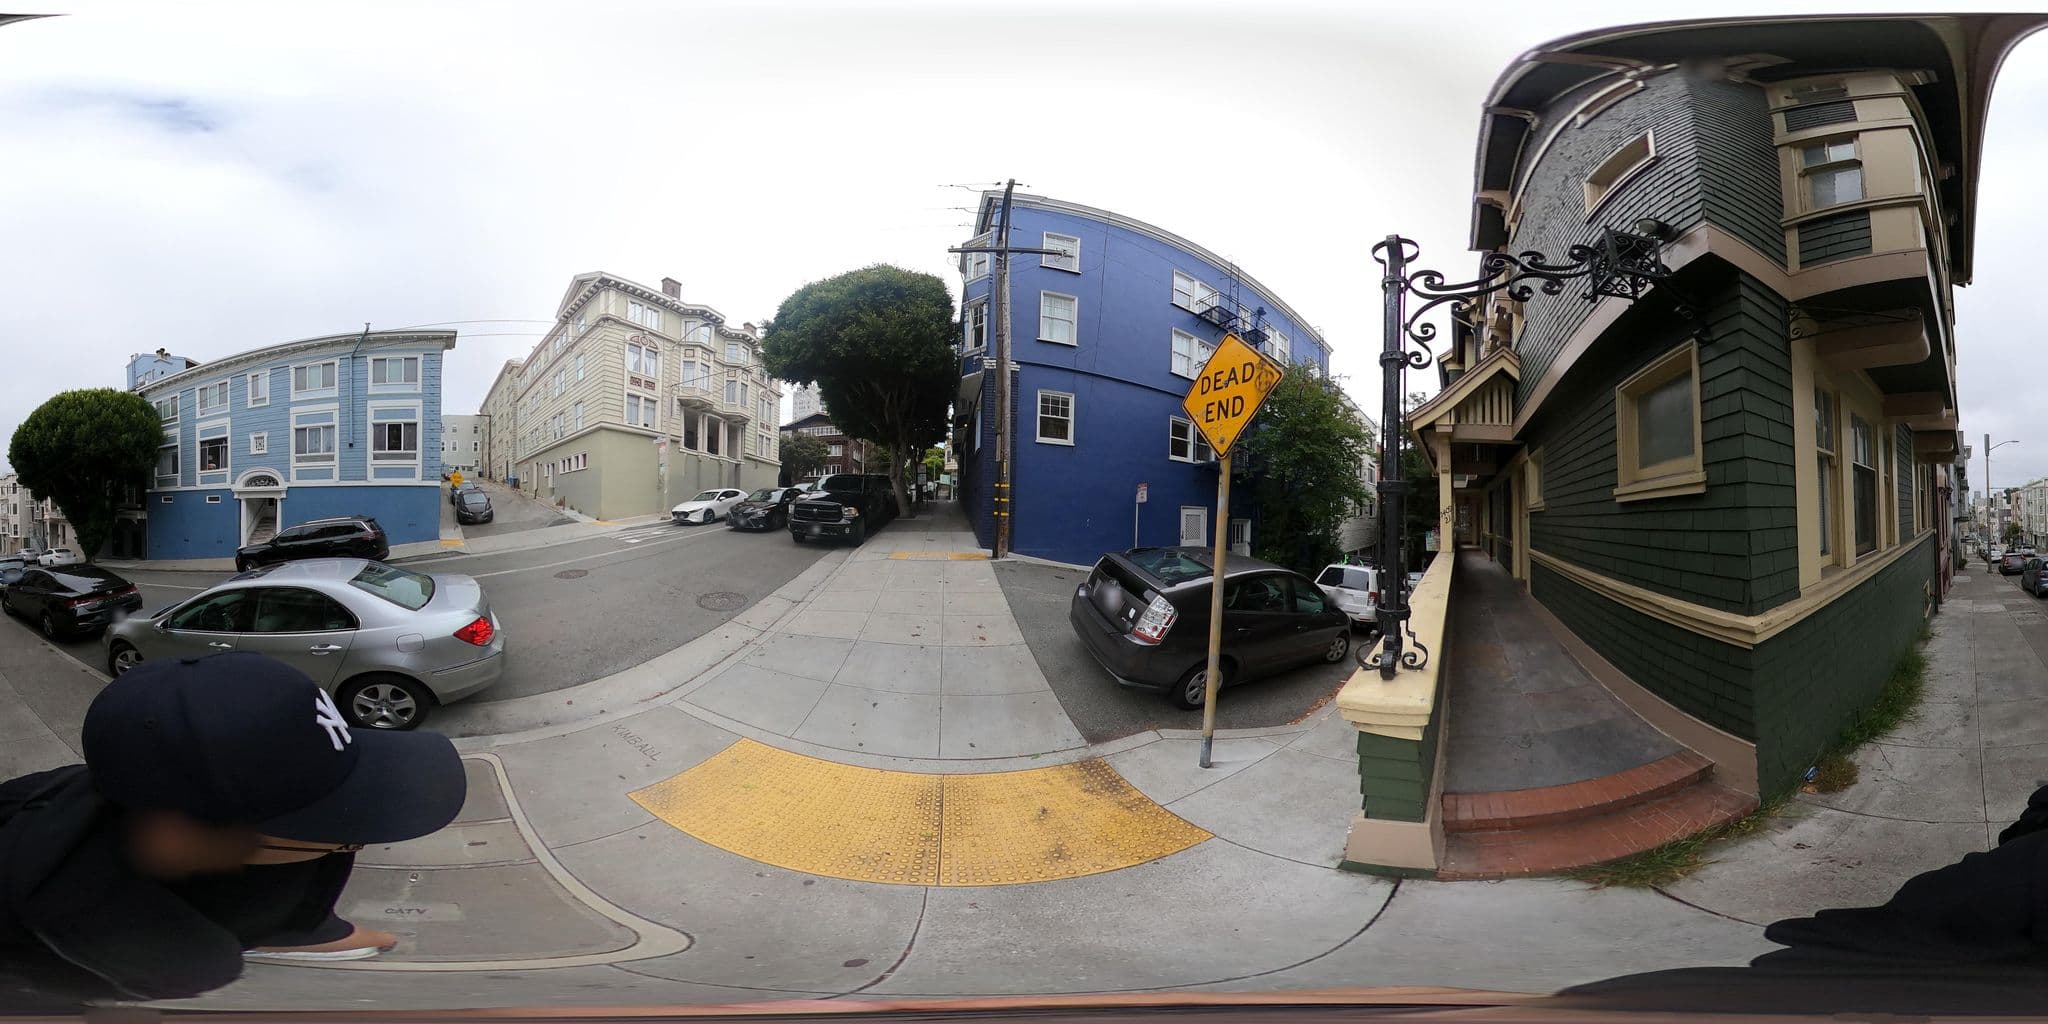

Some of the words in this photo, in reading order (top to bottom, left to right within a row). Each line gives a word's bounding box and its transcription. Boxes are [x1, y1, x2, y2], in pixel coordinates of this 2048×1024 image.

[1200, 361, 1255, 396] DEAD
[1205, 395, 1245, 423] END
[315, 687, 352, 751] NY
[611, 724, 662, 761] KIMBALL
